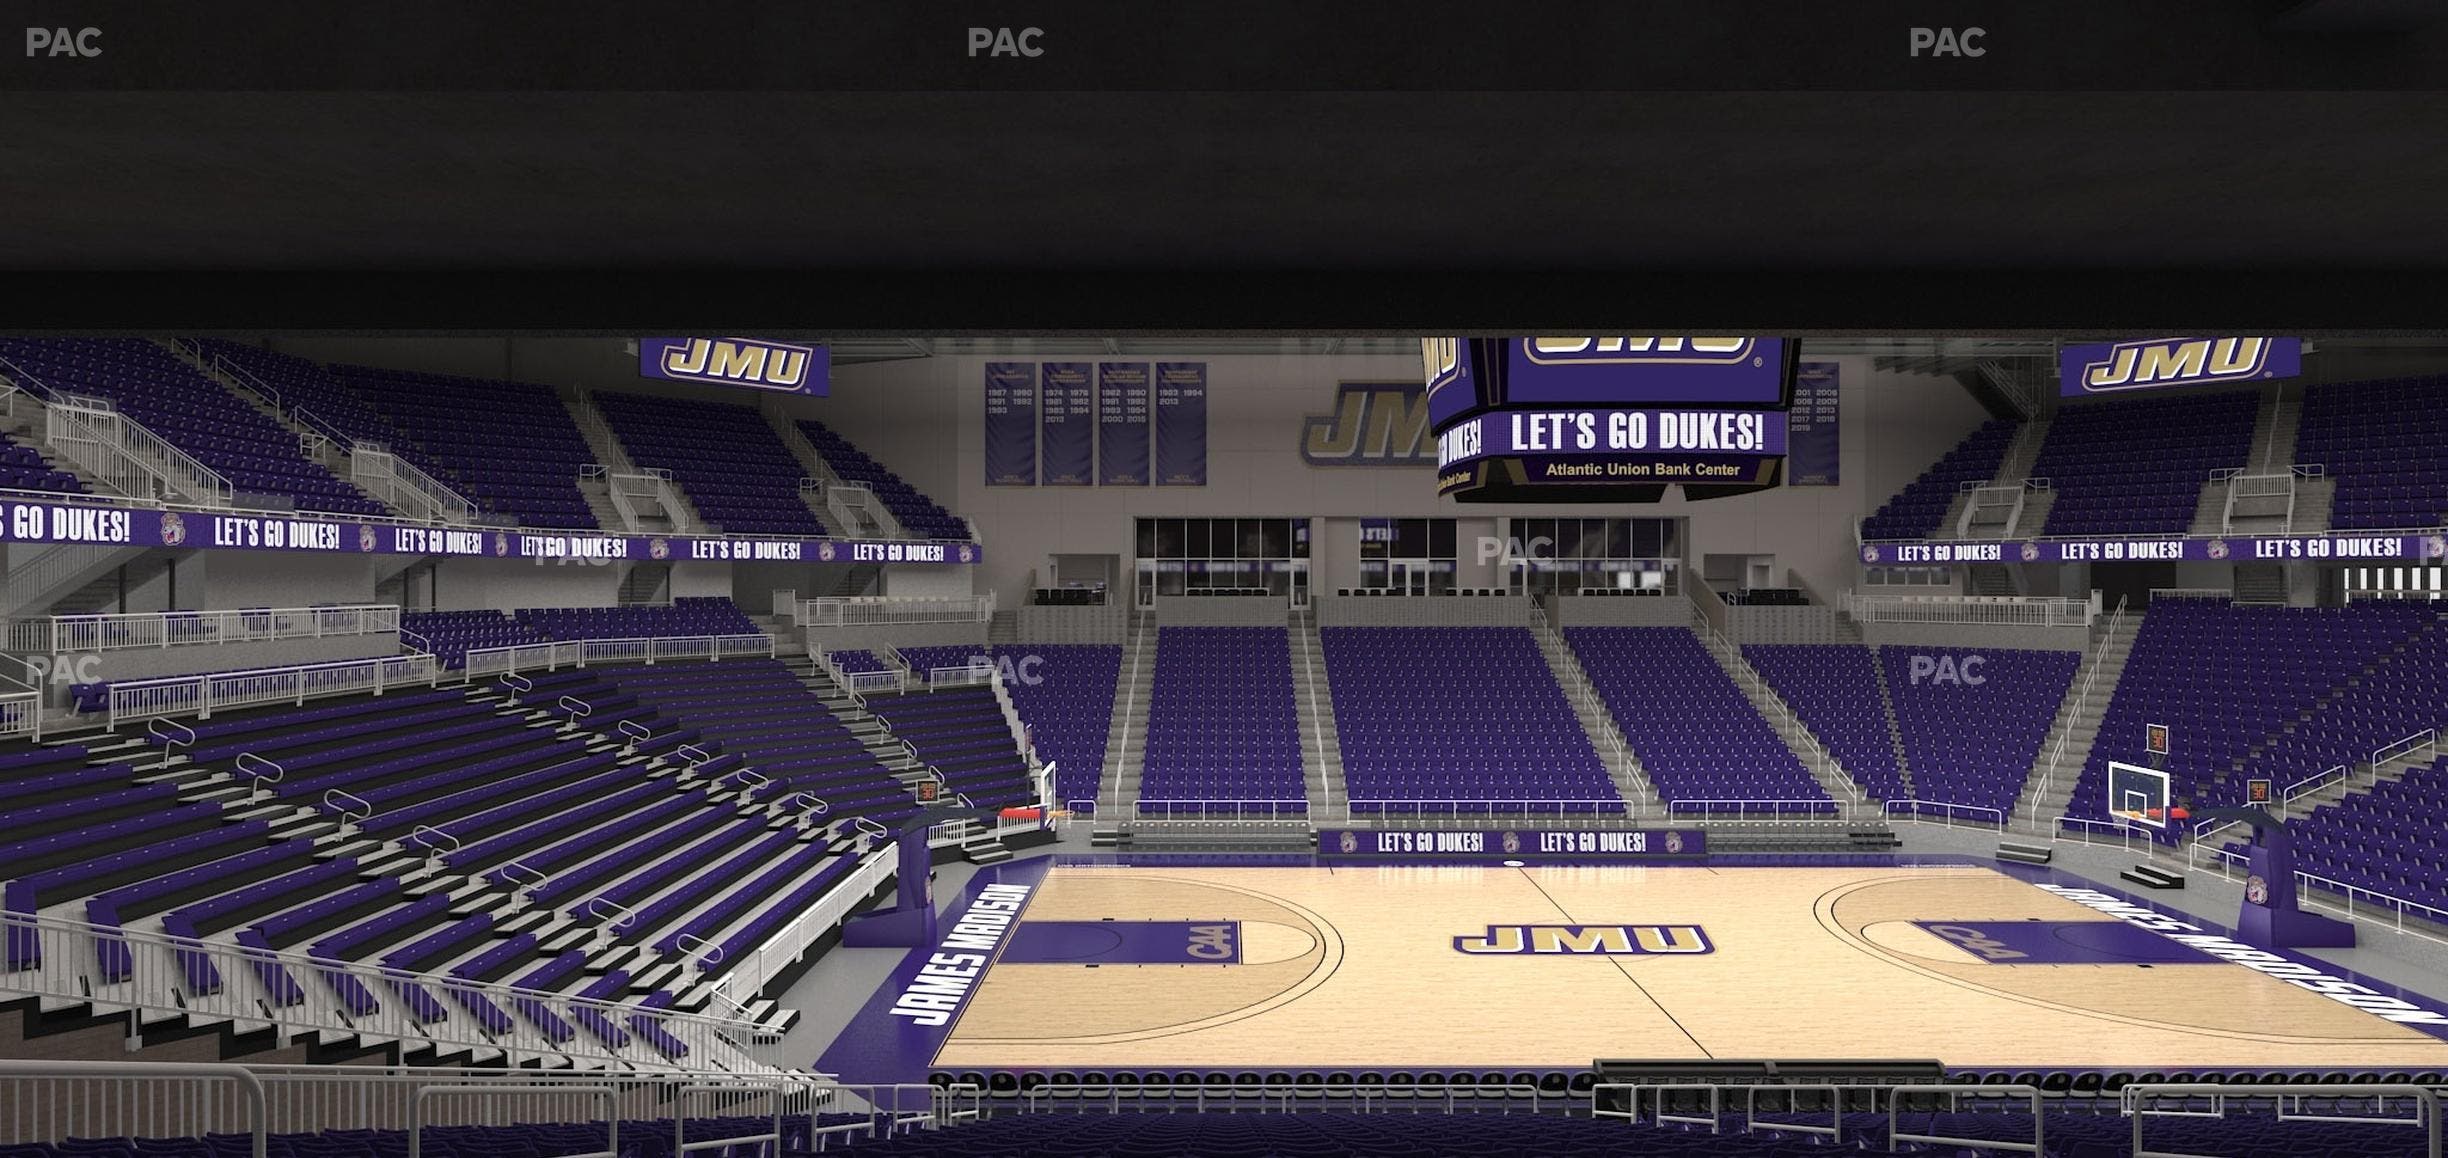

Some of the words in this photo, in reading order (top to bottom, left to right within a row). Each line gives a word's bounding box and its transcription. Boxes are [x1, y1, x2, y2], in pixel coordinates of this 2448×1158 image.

[667, 338, 806, 385] JMU
[2090, 338, 2263, 386] JMU
[1307, 390, 1439, 457] JM
[1511, 412, 1596, 450] LET'S
[1608, 412, 1648, 450] GO
[1659, 412, 1764, 450] DUKES!
[1546, 462, 1602, 476] Atlantic
[1607, 463, 1650, 476] Union
[1655, 462, 1691, 476] Bank
[1695, 463, 1740, 476] Center
[14, 505, 44, 539] GO
[53, 507, 130, 543] DUKES!
[215, 517, 258, 547] LET'S
[264, 520, 284, 548] GO
[290, 521, 340, 549] DUKES!
[395, 528, 425, 552] LET'S
[429, 530, 443, 553] GO
[446, 531, 482, 555] DUKES!
[545, 537, 566, 558] GO
[571, 538, 627, 558] DUKES!
[692, 541, 728, 559] LET'S
[733, 541, 751, 560] GO
[755, 541, 800, 560] DUKES!
[854, 544, 884, 561] LET'S
[888, 544, 901, 561] GO
[905, 545, 944, 562] DUKES!
[1897, 545, 1930, 561] LET'S
[1934, 545, 1950, 561] GO
[1955, 544, 2001, 561] DUKES!
[2061, 543, 2099, 560] LET'S
[2104, 542, 2123, 560] GO
[2128, 541, 2183, 559] DUKES!
[2256, 539, 2301, 558] LET'S
[2307, 539, 2329, 557] GO
[2336, 538, 2402, 557] DUKES!
[1378, 832, 1412, 852] LET'S
[1416, 832, 1433, 852] GO
[1437, 832, 1483, 852] DUKES!
[1540, 832, 1575, 852] LET'S
[1579, 832, 1595, 852] GO
[1600, 832, 1646, 852] DUKES!
[1187, 925, 1232, 959] CAA
[1456, 925, 1711, 954] JMU
[2034, 883, 2203, 931] JAMES
[2163, 934, 2448, 1024] MADISON
[889, 952, 987, 1026] JAMES
[941, 883, 1031, 950] MADISON
